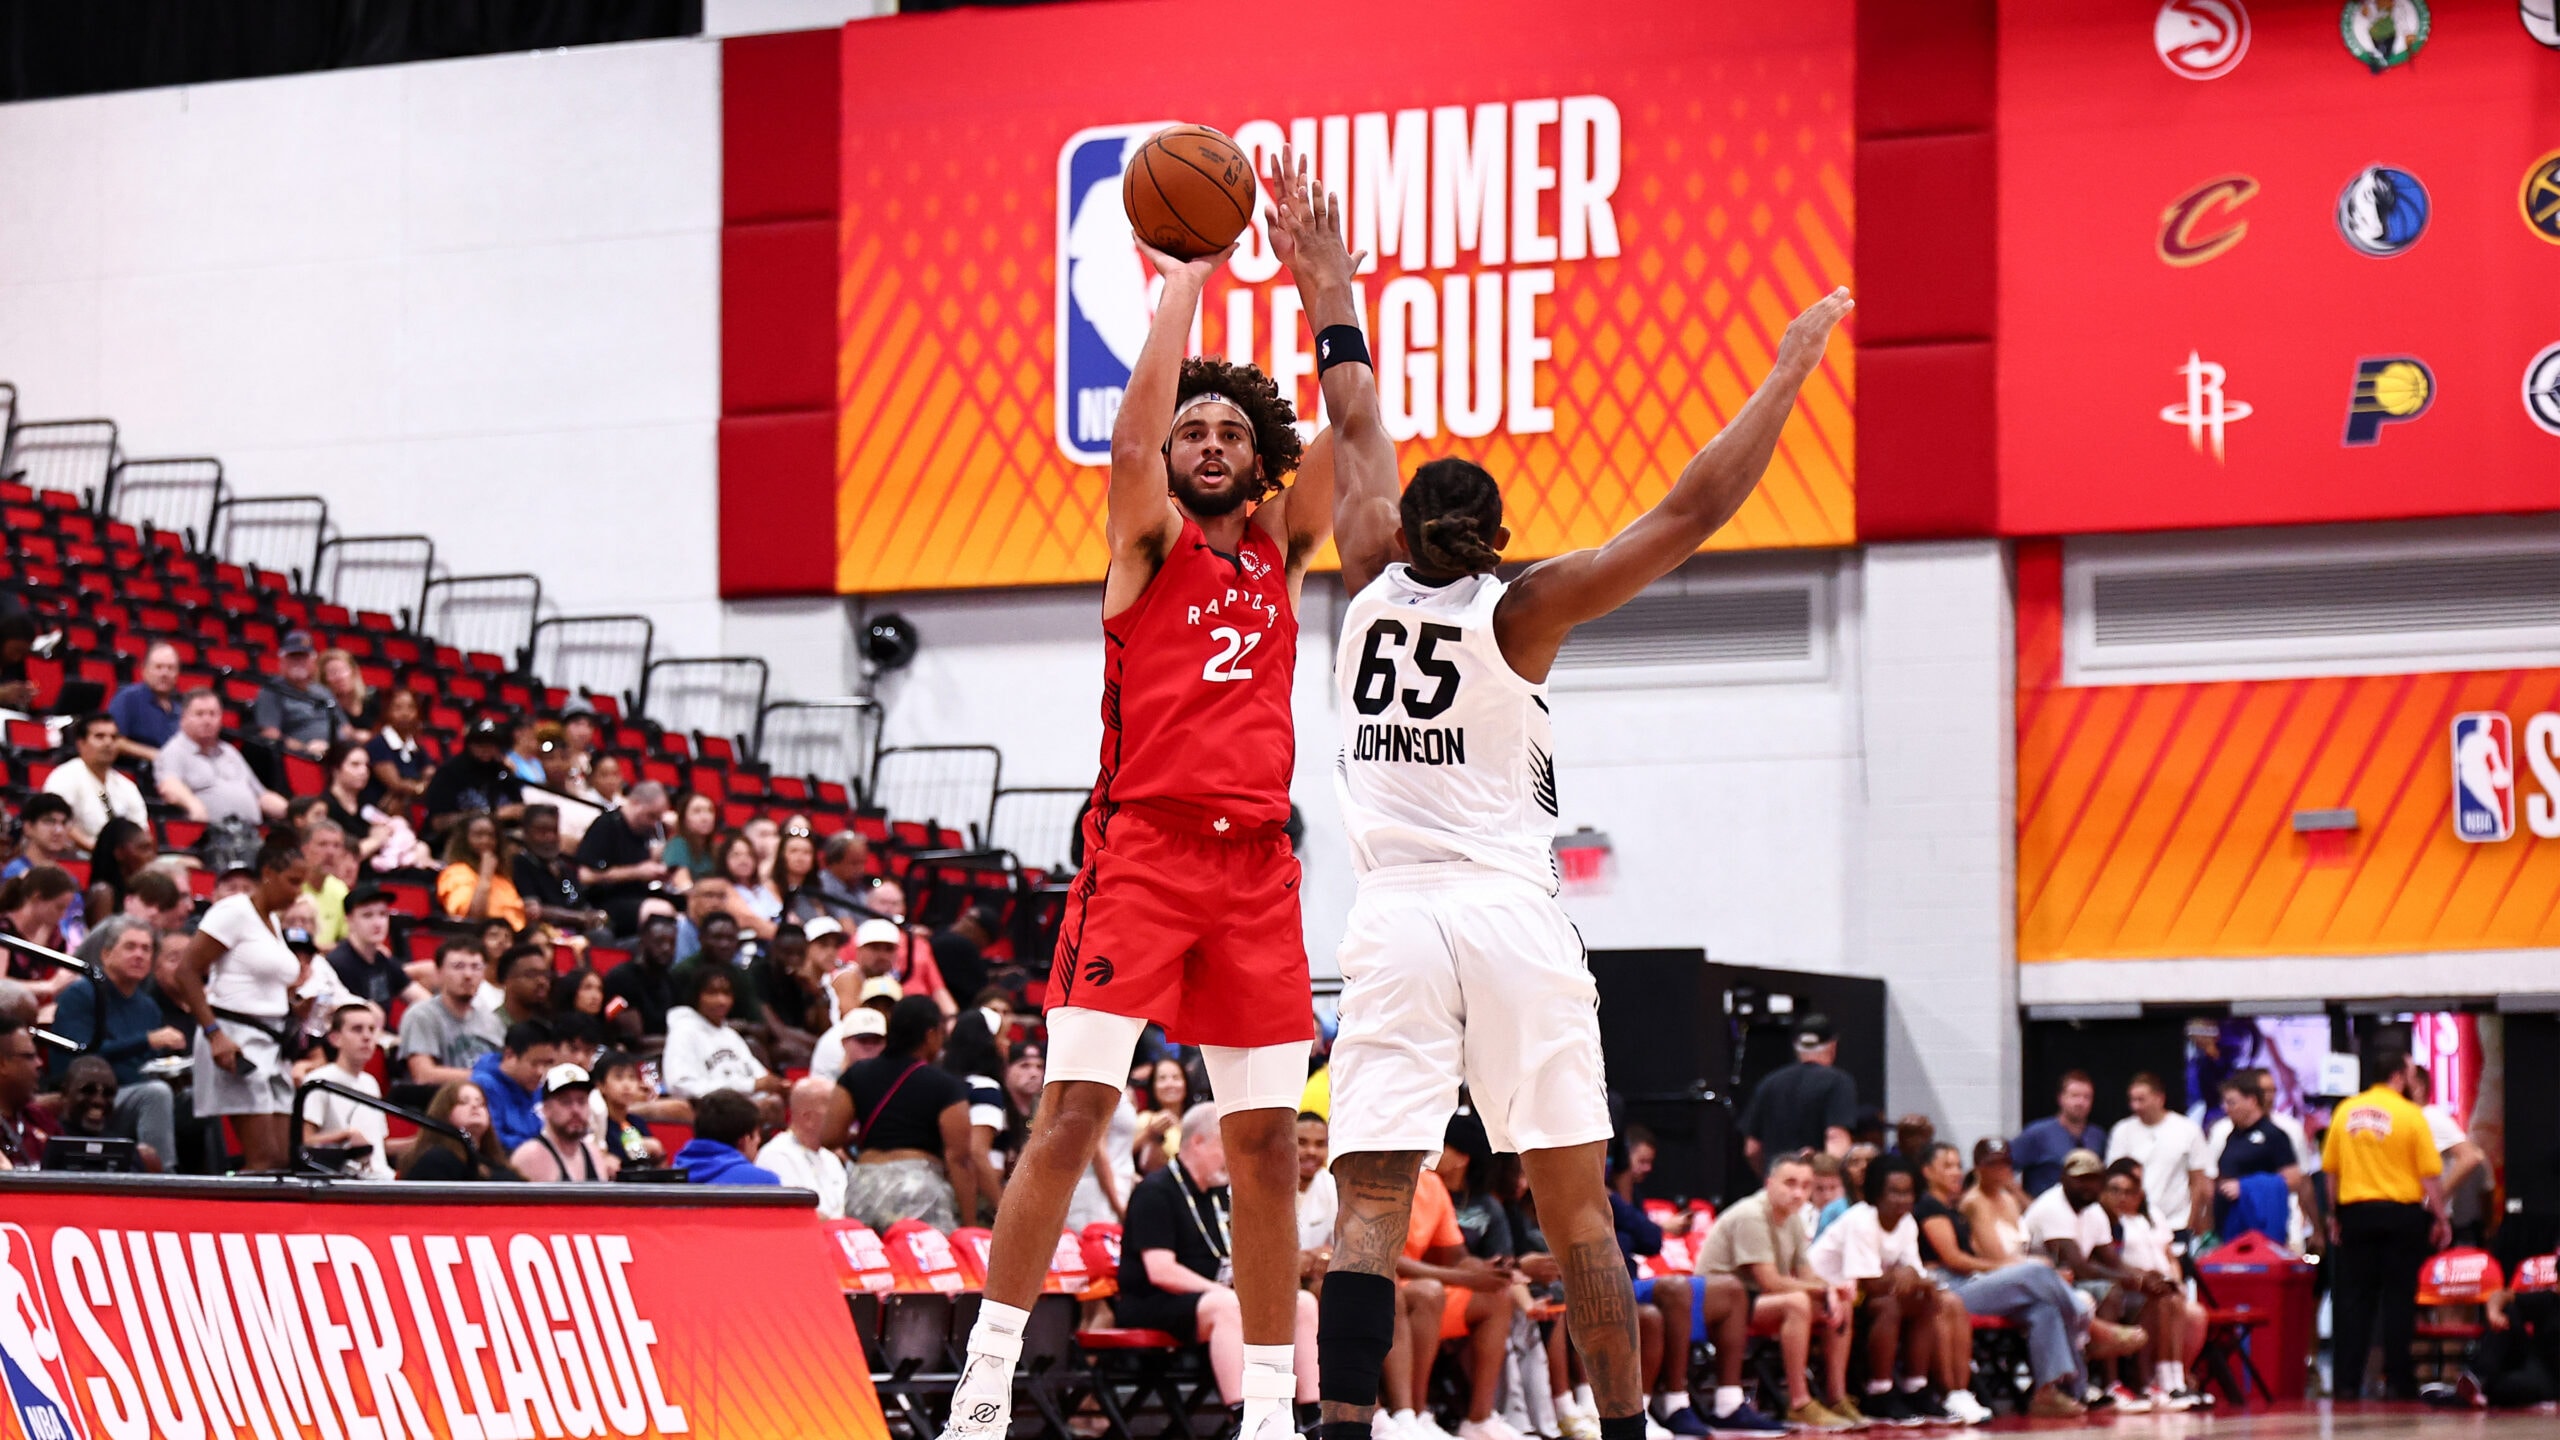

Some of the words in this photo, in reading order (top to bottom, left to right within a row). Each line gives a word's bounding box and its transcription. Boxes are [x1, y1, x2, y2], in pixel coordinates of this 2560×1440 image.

[1228, 94, 1621, 283] SUMMER
[1227, 268, 1555, 442] EGUE
[1078, 385, 1124, 442] NB
[1187, 588, 1279, 629] RAPOR
[1202, 626, 1262, 682] 22
[1352, 618, 1462, 720] 65
[1353, 724, 1466, 766] JOHNSON
[2464, 812, 2494, 834] NBA
[51, 1226, 436, 1440] SUMMER
[389, 1233, 690, 1440] LEAGUE
[25, 1405, 68, 1440] NBA
